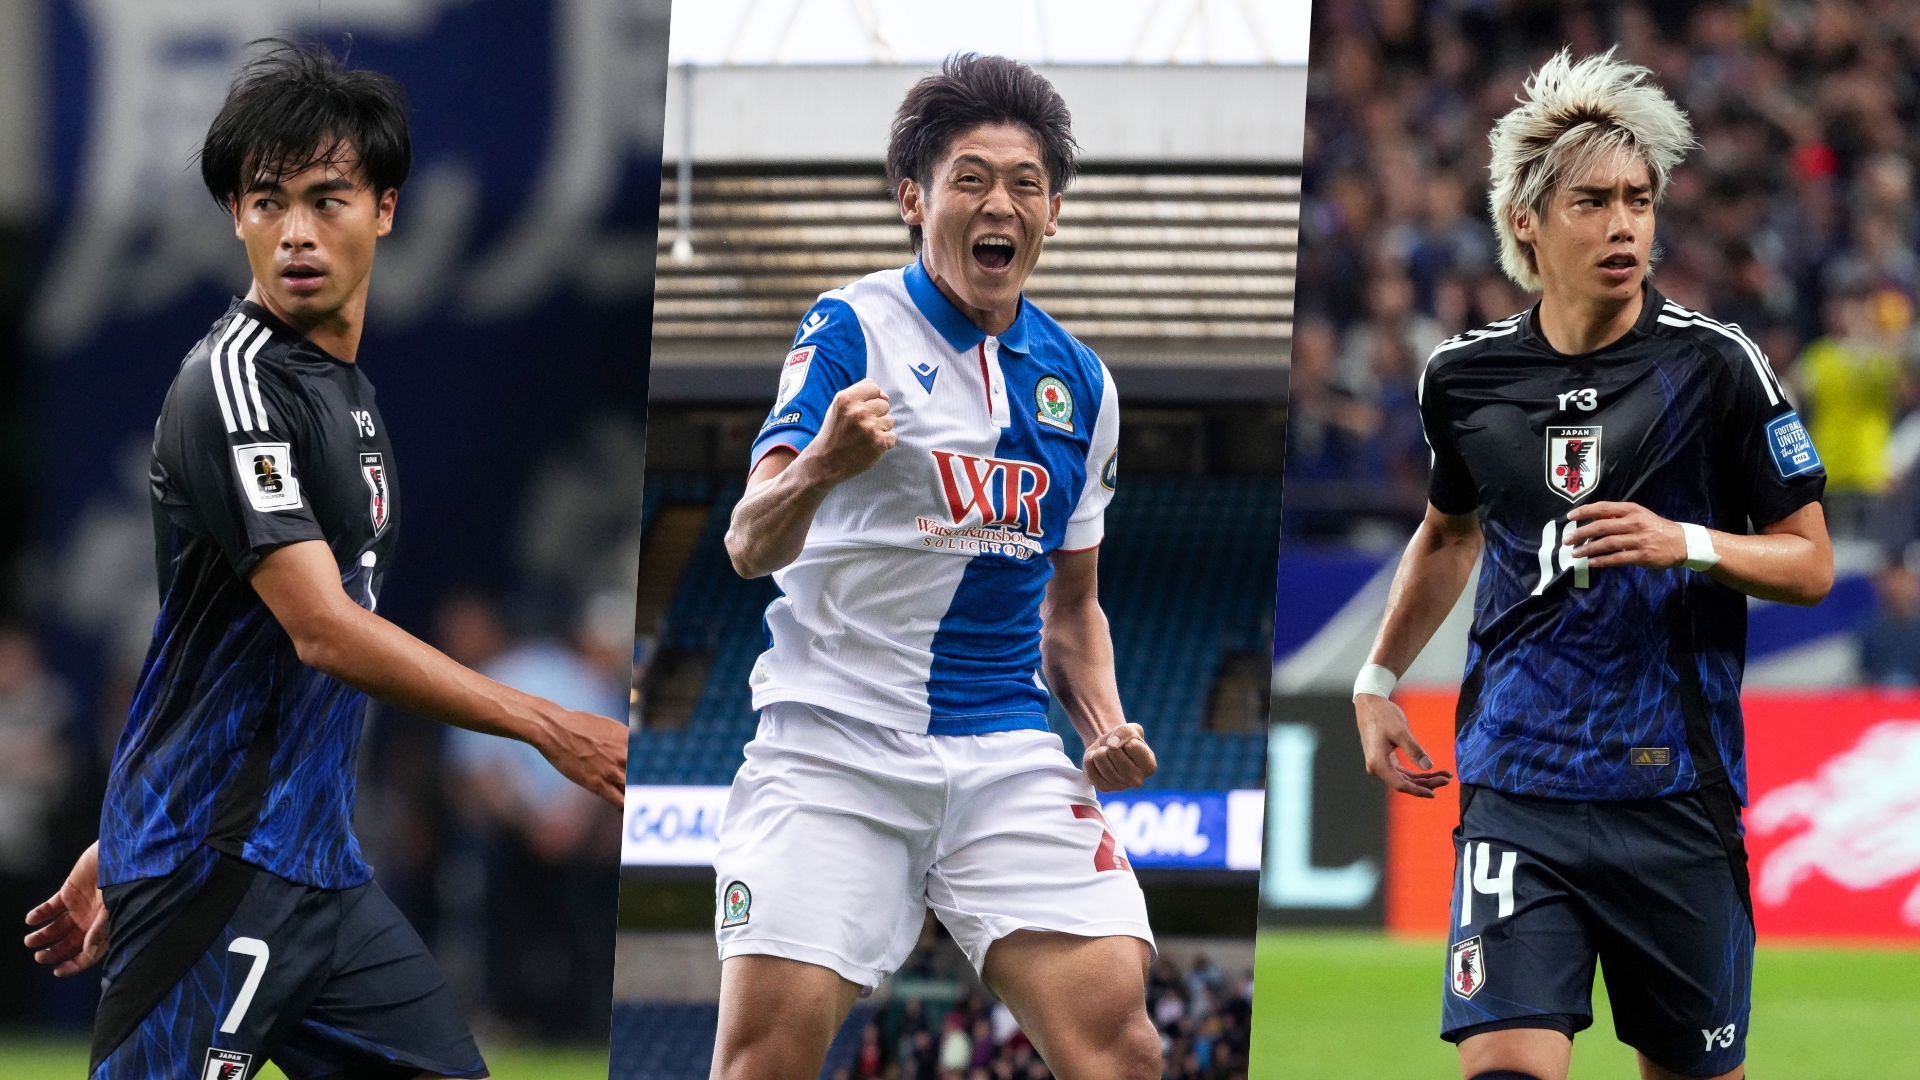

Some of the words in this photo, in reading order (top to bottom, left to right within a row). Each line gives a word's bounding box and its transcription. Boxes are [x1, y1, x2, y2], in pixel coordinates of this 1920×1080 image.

[1556, 388, 1598, 411] Y-3
[351, 410, 376, 438] Y-3
[1774, 420, 1802, 437] FOOTBALL
[1777, 429, 1806, 448] UNITES
[1780, 447, 1794, 458] the
[1793, 438, 1811, 453] World
[1795, 454, 1808, 462] FIFA
[1561, 477, 1586, 489] JFA
[923, 537, 1033, 560] SOLICITORS
[1460, 841, 1517, 927] 14
[1458, 940, 1474, 950] JAPAN
[219, 936, 270, 1034] 7
[1701, 1023, 1736, 1052] Y-3
[218, 1052, 242, 1061] JAPAN
